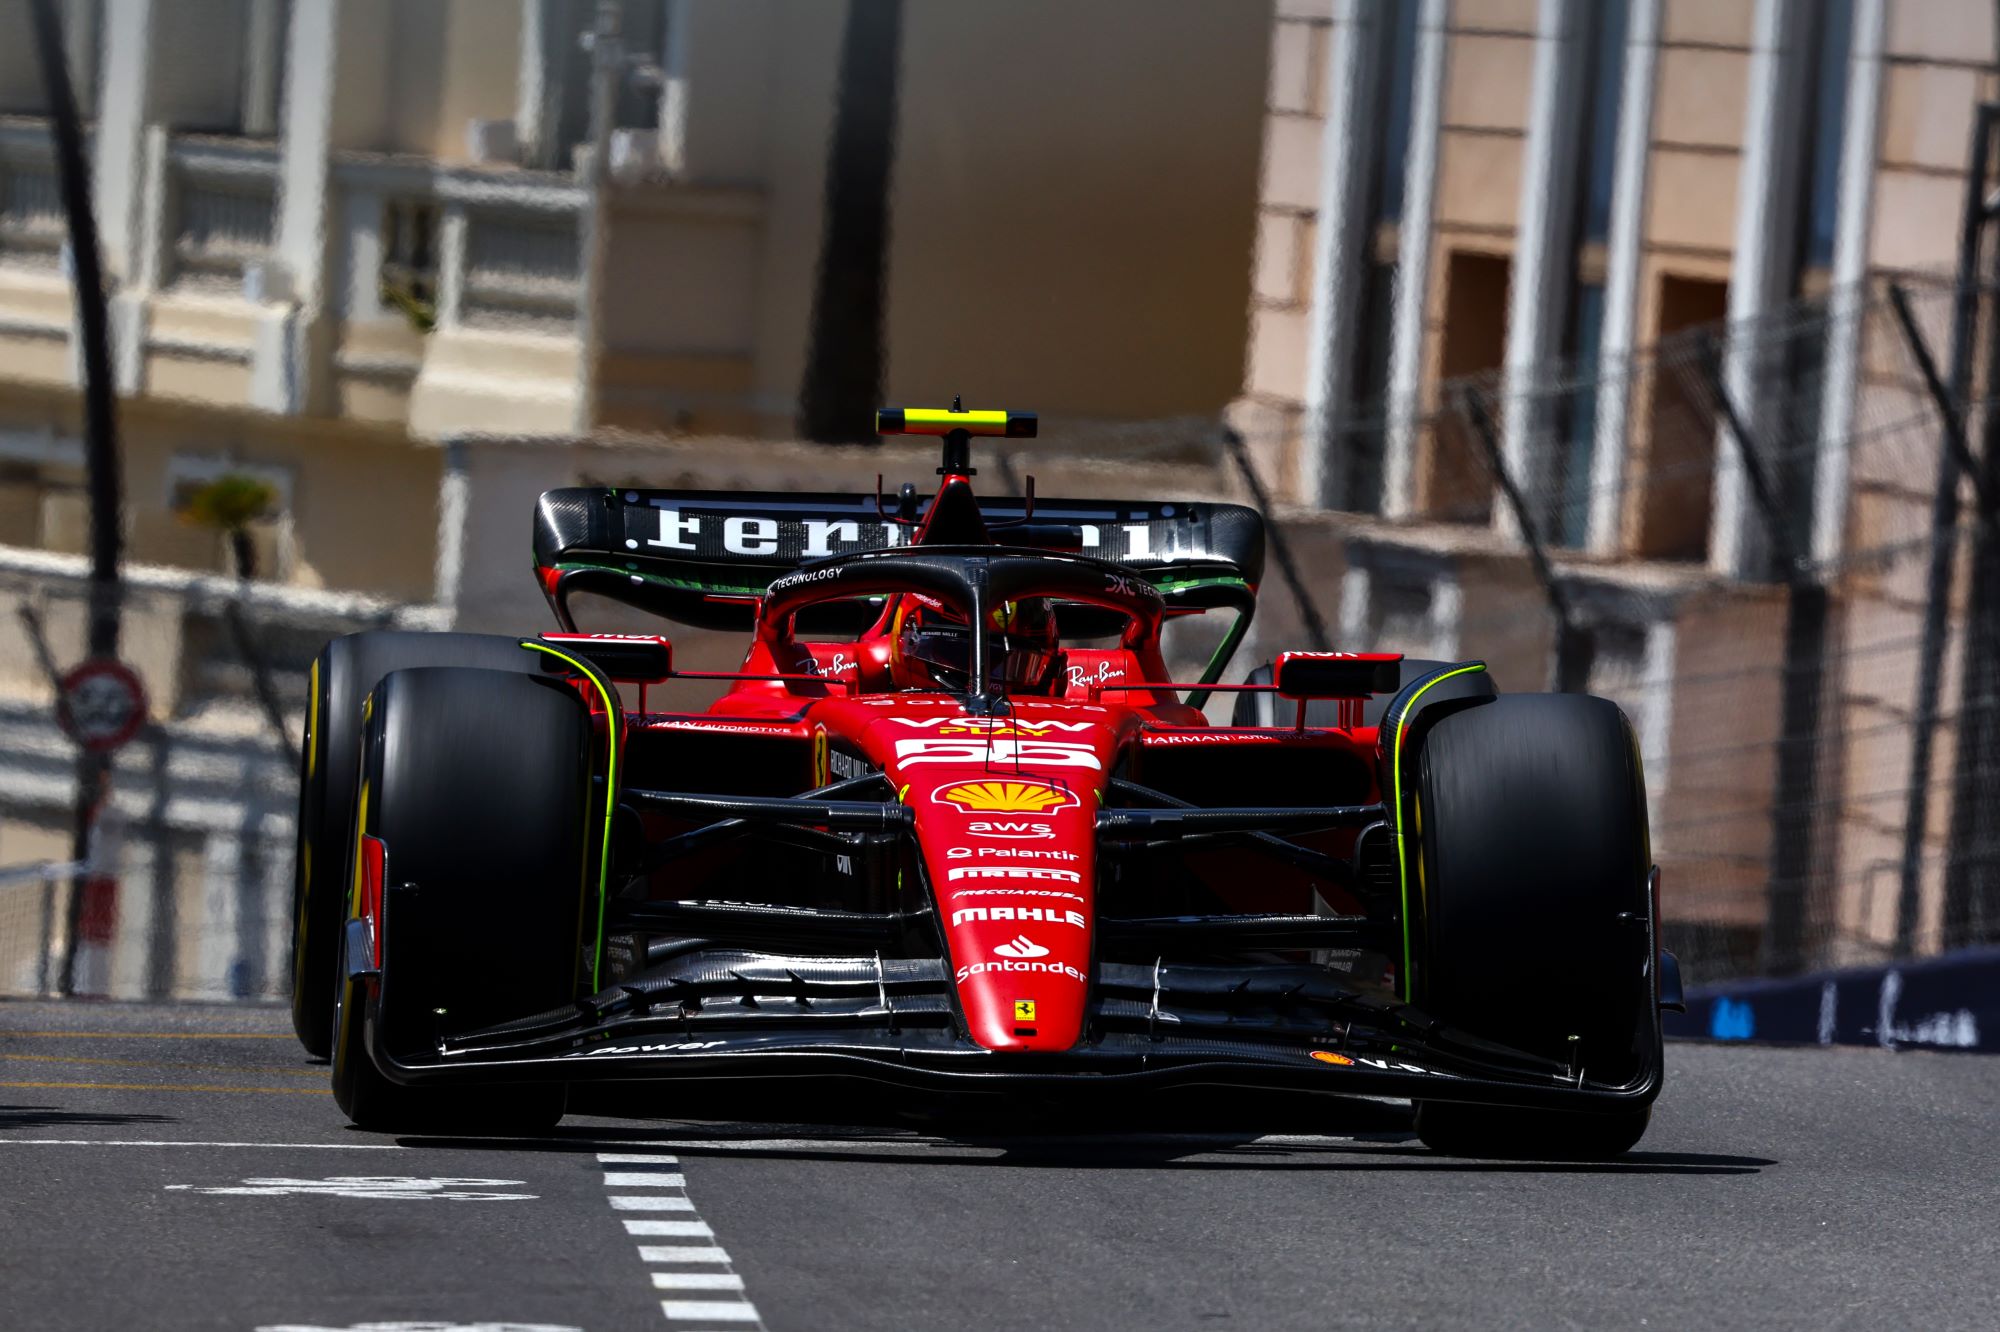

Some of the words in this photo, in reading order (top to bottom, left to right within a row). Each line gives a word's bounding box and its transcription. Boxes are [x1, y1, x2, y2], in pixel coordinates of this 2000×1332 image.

[777, 568, 843, 590] TECHNOLOGY
[796, 653, 858, 677] Ray-Ban
[1065, 661, 1125, 687] Ray-Ban
[702, 723, 792, 733] AUTOMOTIVE
[888, 717, 1096, 732] VGW
[939, 727, 1053, 736] PLAY
[1140, 734, 1230, 744] HARMAN
[895, 739, 1102, 770] 55
[968, 821, 1052, 834] aws
[978, 847, 1080, 861] Palantir
[948, 866, 1082, 883] PIRELLI
[952, 907, 1085, 929] MAHLE
[956, 959, 1087, 985] Santander
